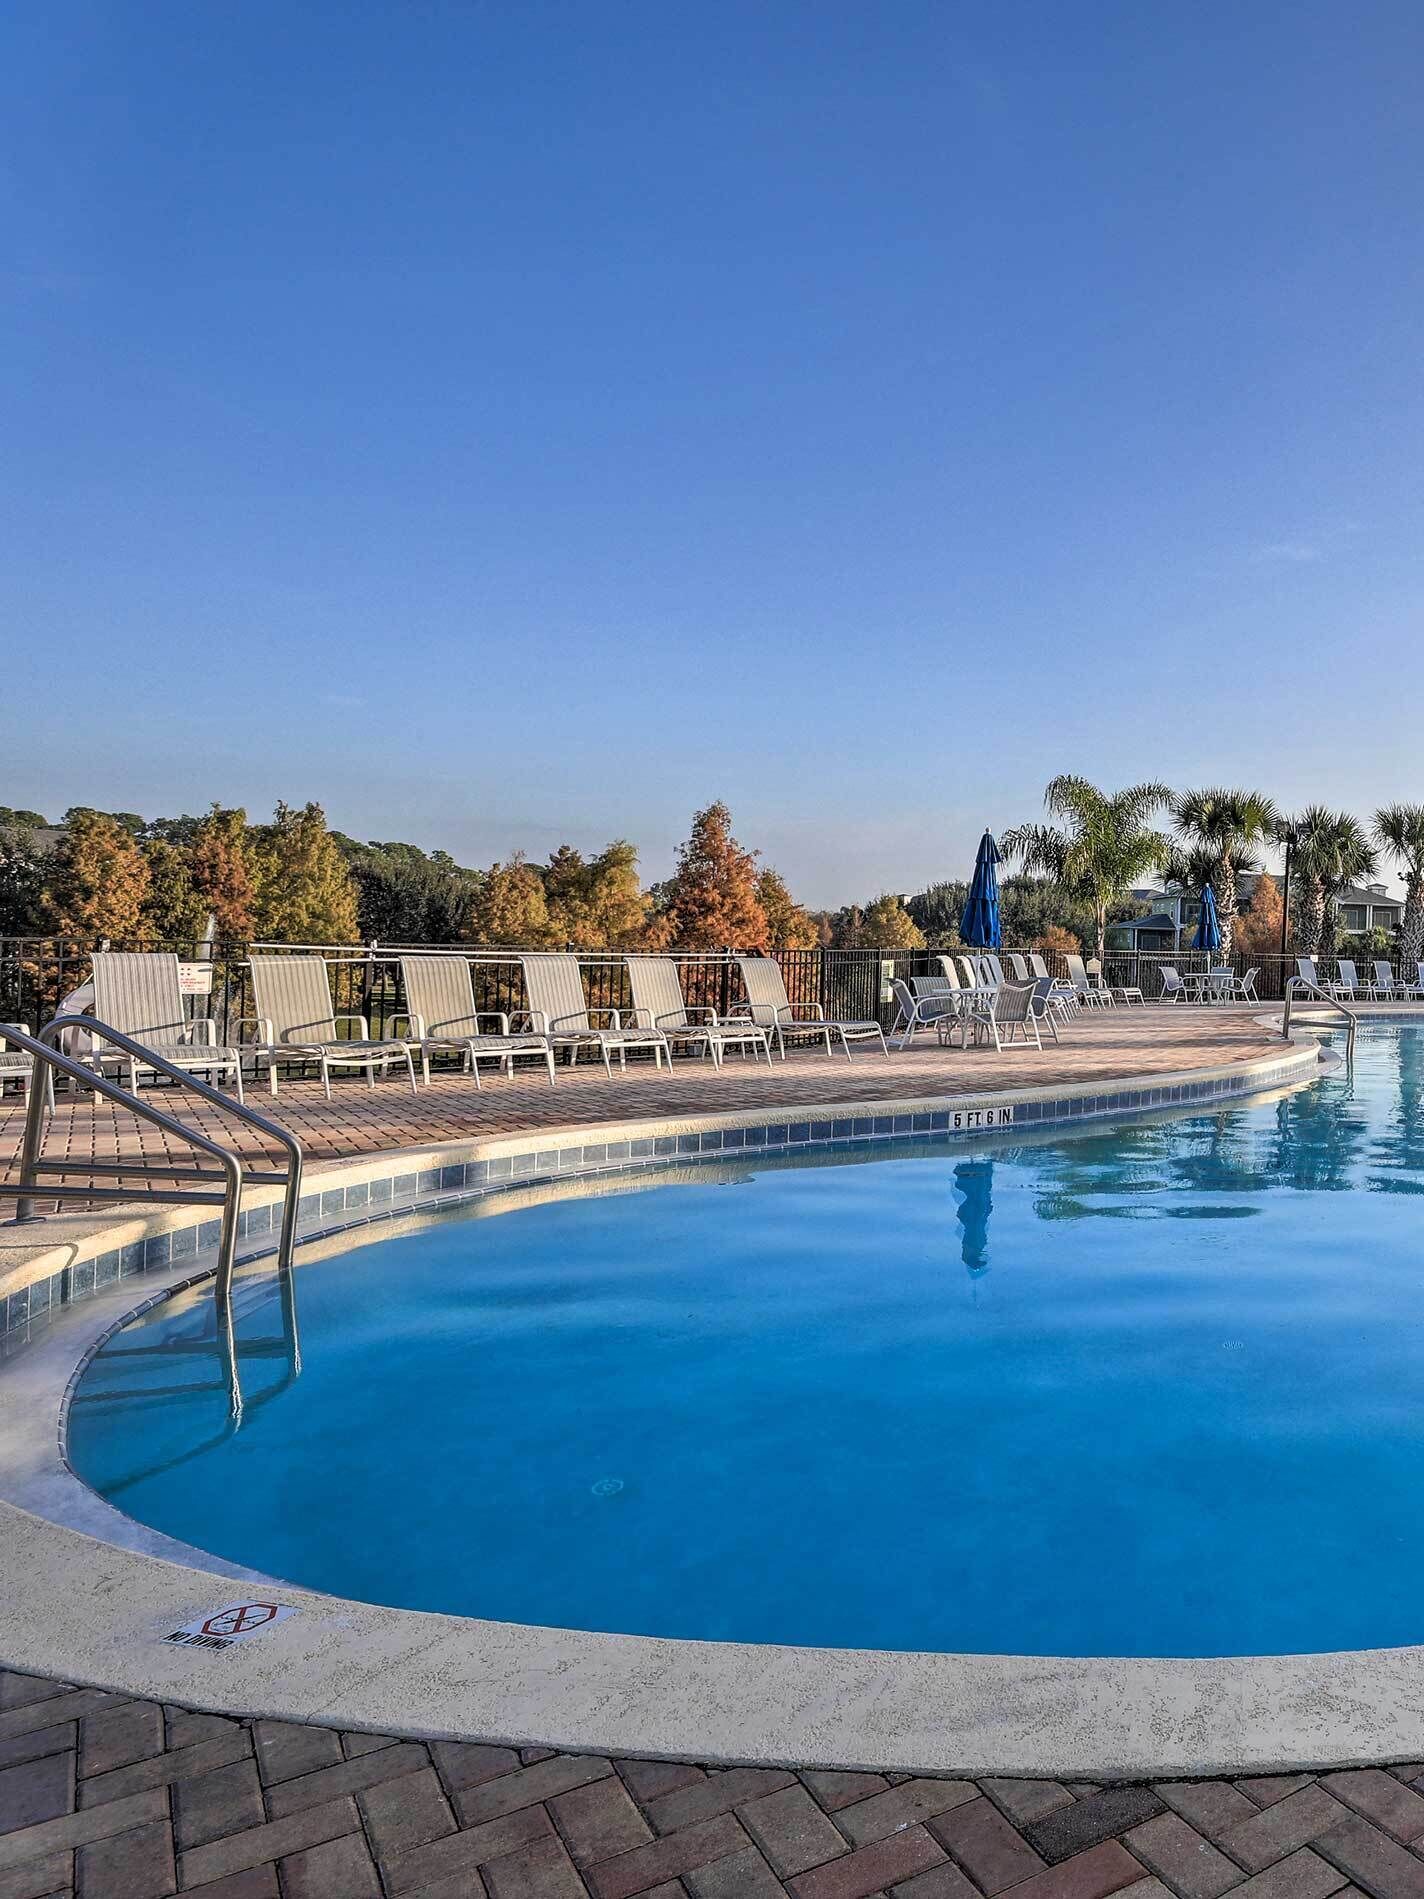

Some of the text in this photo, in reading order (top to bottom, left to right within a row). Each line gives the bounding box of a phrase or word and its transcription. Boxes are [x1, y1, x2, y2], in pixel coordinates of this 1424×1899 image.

[954, 1113, 961, 1127] 5
[987, 1111, 993, 1124] 6
[163, 1631, 235, 1650] NO DIVING
